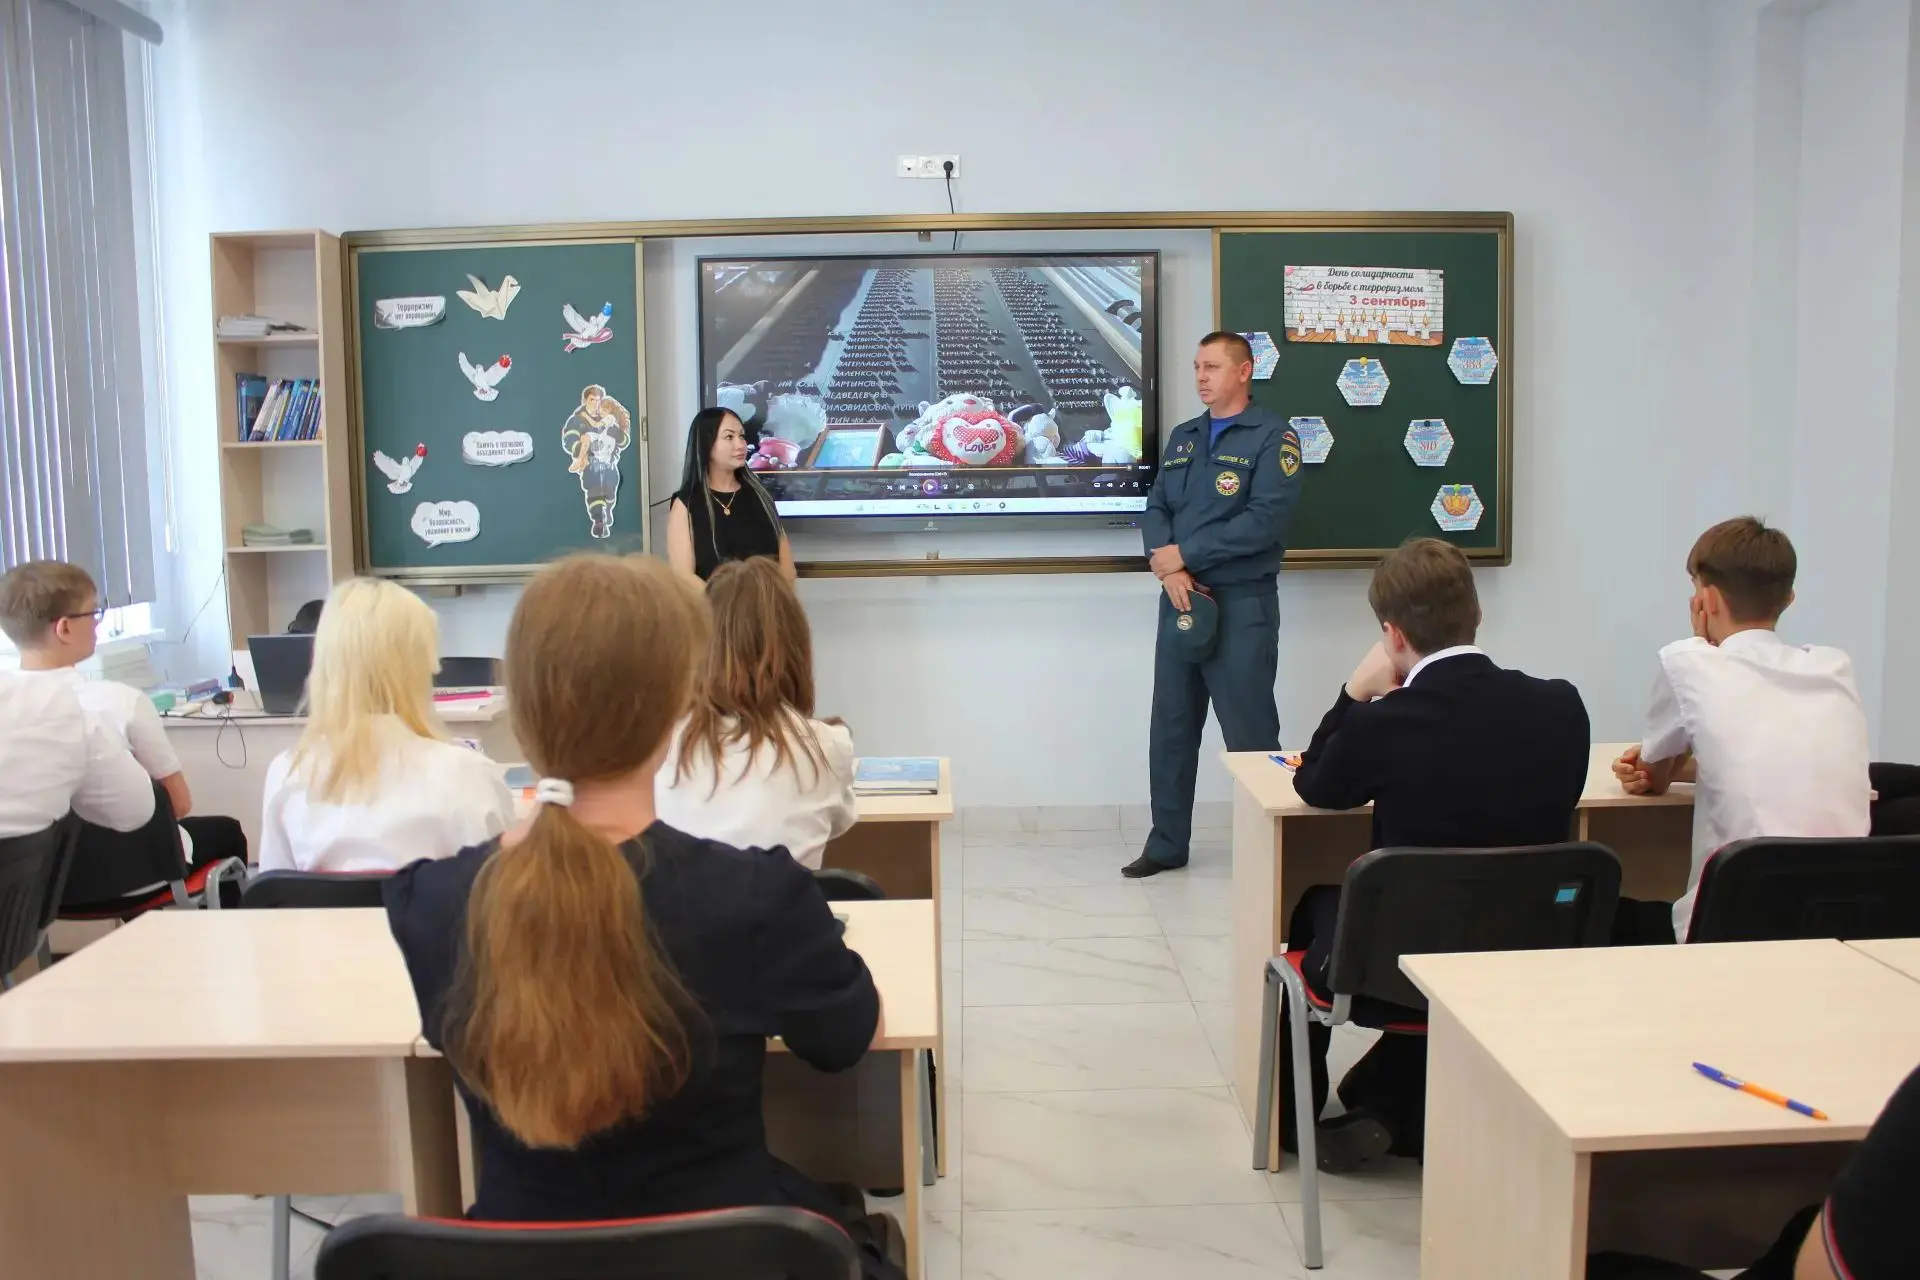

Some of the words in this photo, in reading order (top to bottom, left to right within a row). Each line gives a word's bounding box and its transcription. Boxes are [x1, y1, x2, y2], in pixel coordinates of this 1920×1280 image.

[1327, 267, 1349, 278] День
[1350, 269, 1414, 280] солидарности
[1316, 281, 1322, 290] в
[1323, 281, 1351, 293] борьбе
[1359, 284, 1424, 294] терроризмом
[396, 303, 433, 312] Терроризму
[1350, 295, 1358, 305] 3
[1361, 296, 1426, 309] сентября
